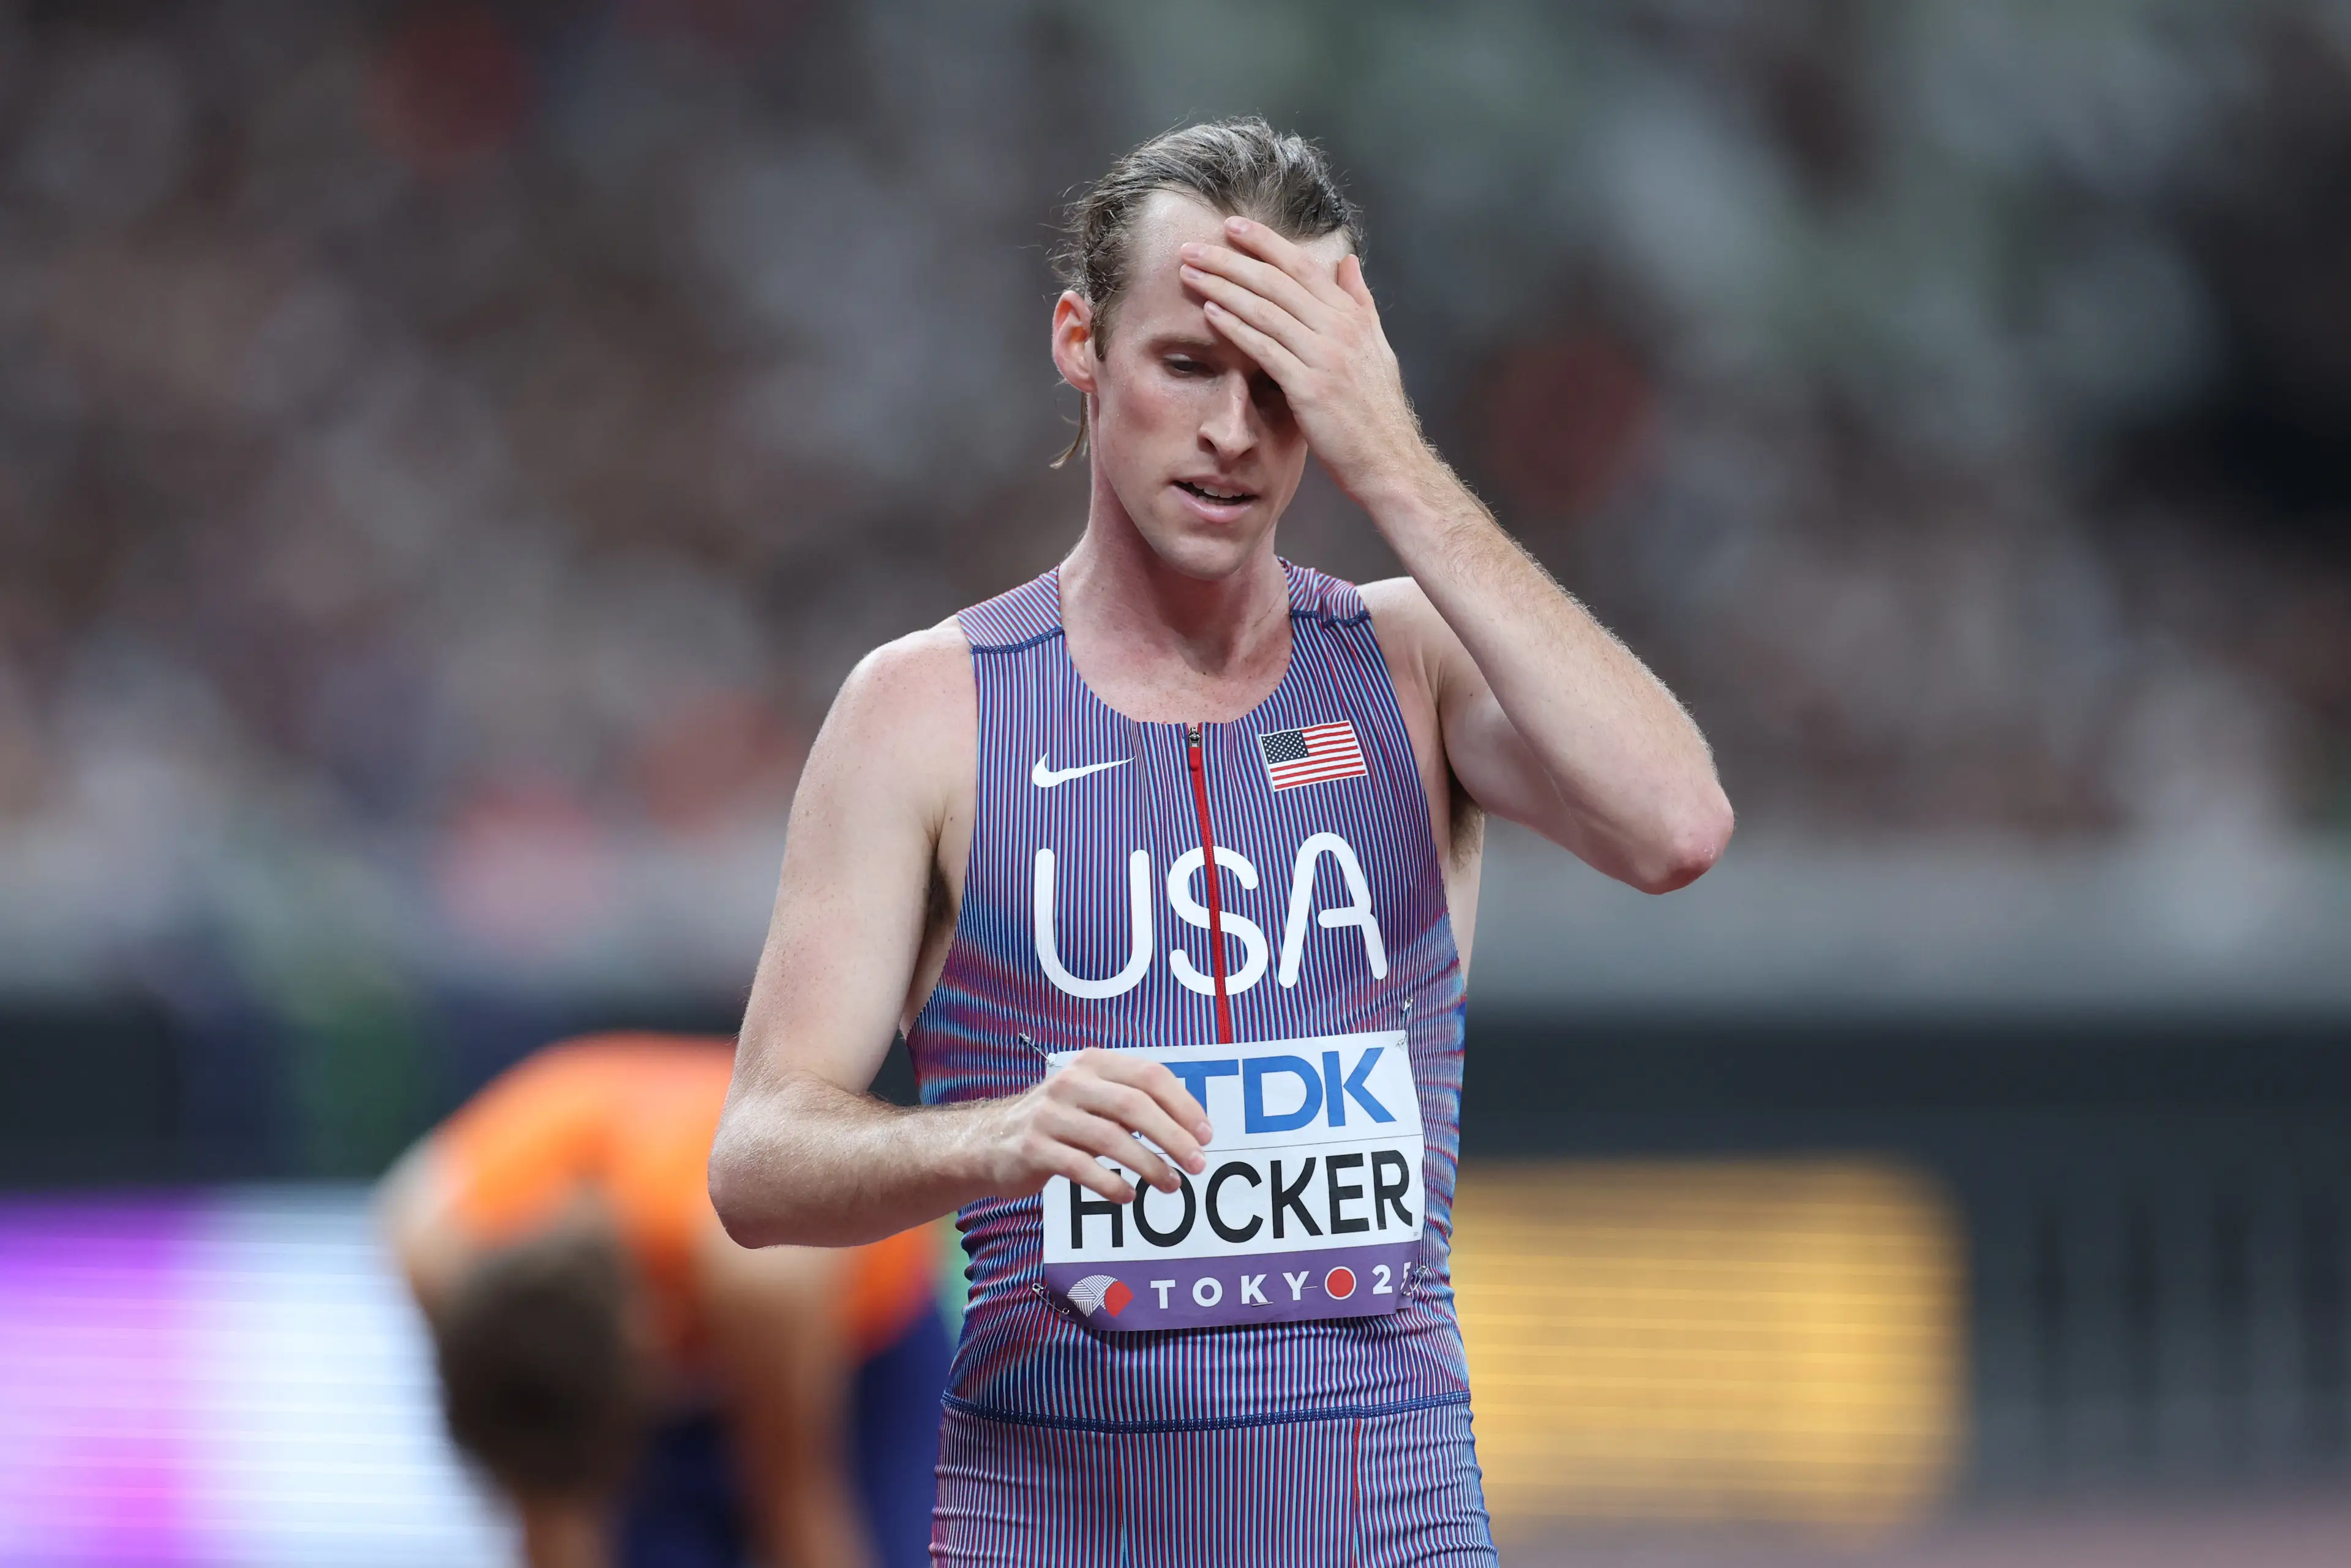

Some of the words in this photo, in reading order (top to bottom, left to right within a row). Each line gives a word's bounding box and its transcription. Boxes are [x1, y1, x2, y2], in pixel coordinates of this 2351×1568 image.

[1034, 832, 1388, 999] USA
[1160, 1047, 1397, 1134] TDK
[1070, 1150, 1412, 1249] HOCKER
